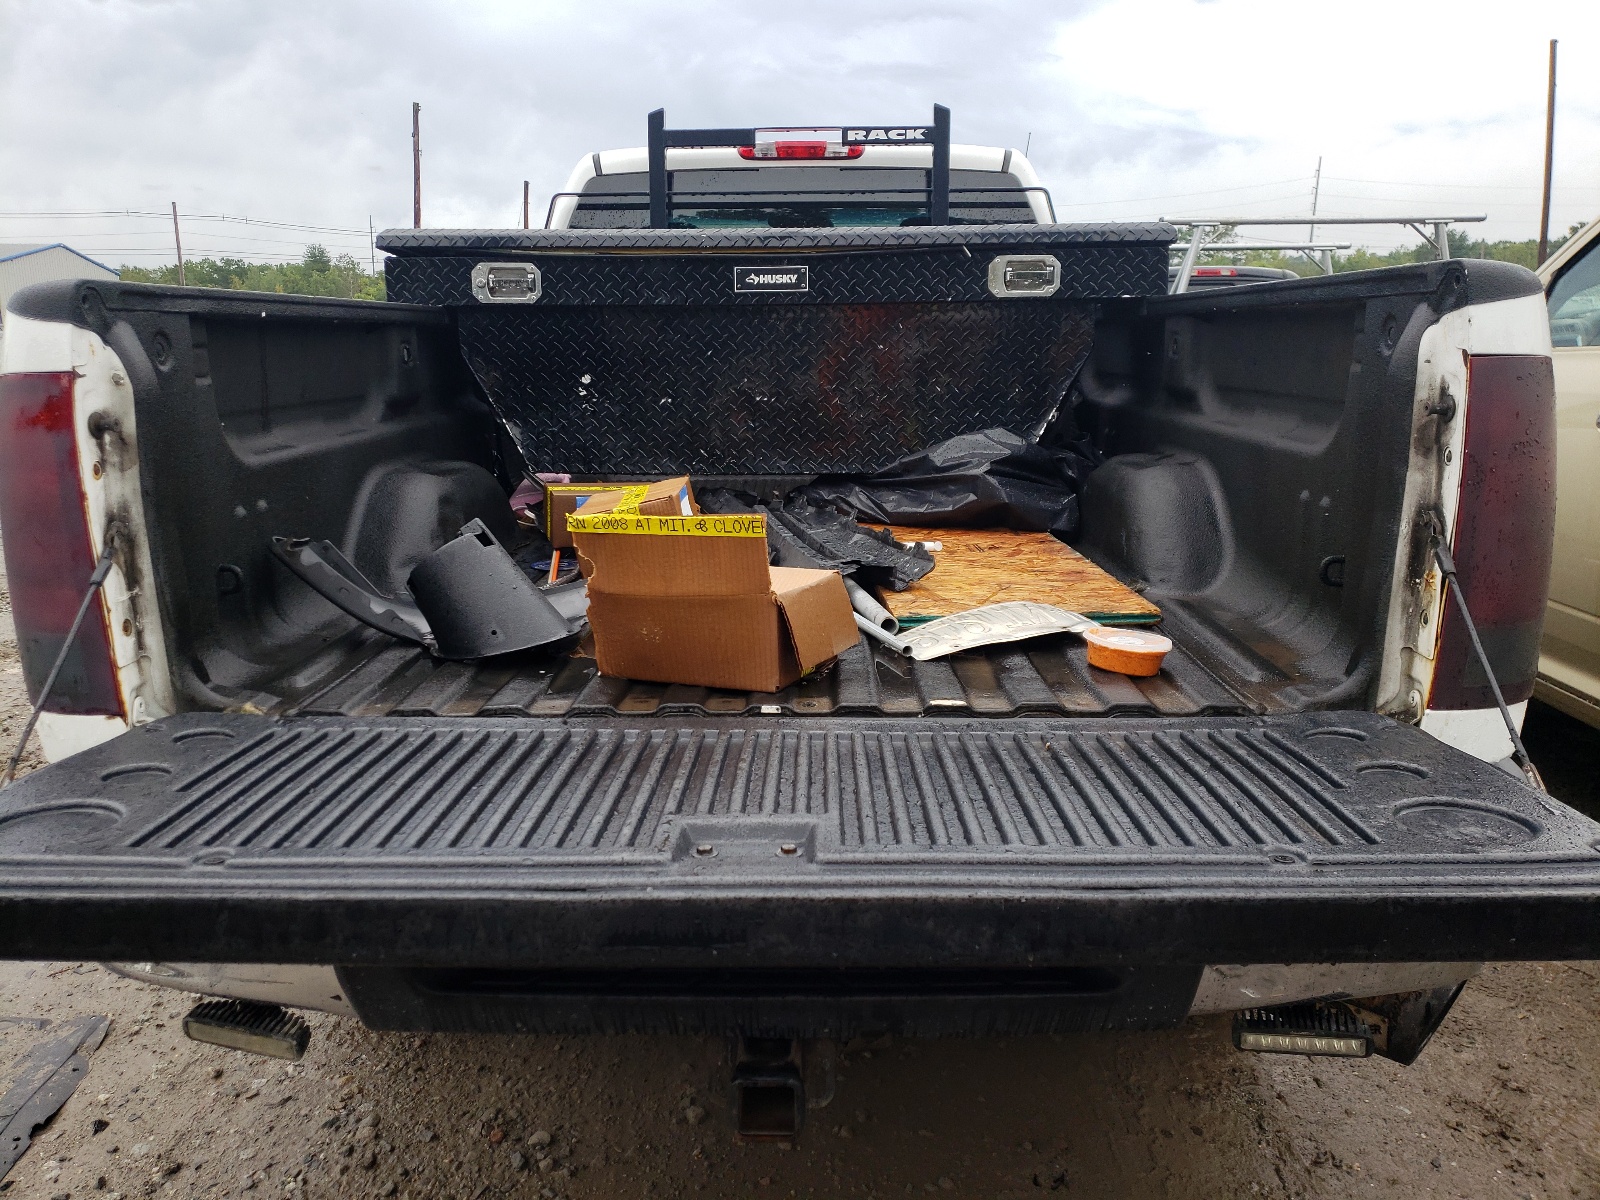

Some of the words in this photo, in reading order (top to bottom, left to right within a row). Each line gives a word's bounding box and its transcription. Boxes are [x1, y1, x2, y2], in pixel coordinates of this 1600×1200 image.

[847, 128, 927, 141] RACK
[759, 274, 798, 284] HUSKY
[592, 517, 629, 530] 2008
[635, 518, 651, 531] AT
[660, 518, 692, 533] MIT.
